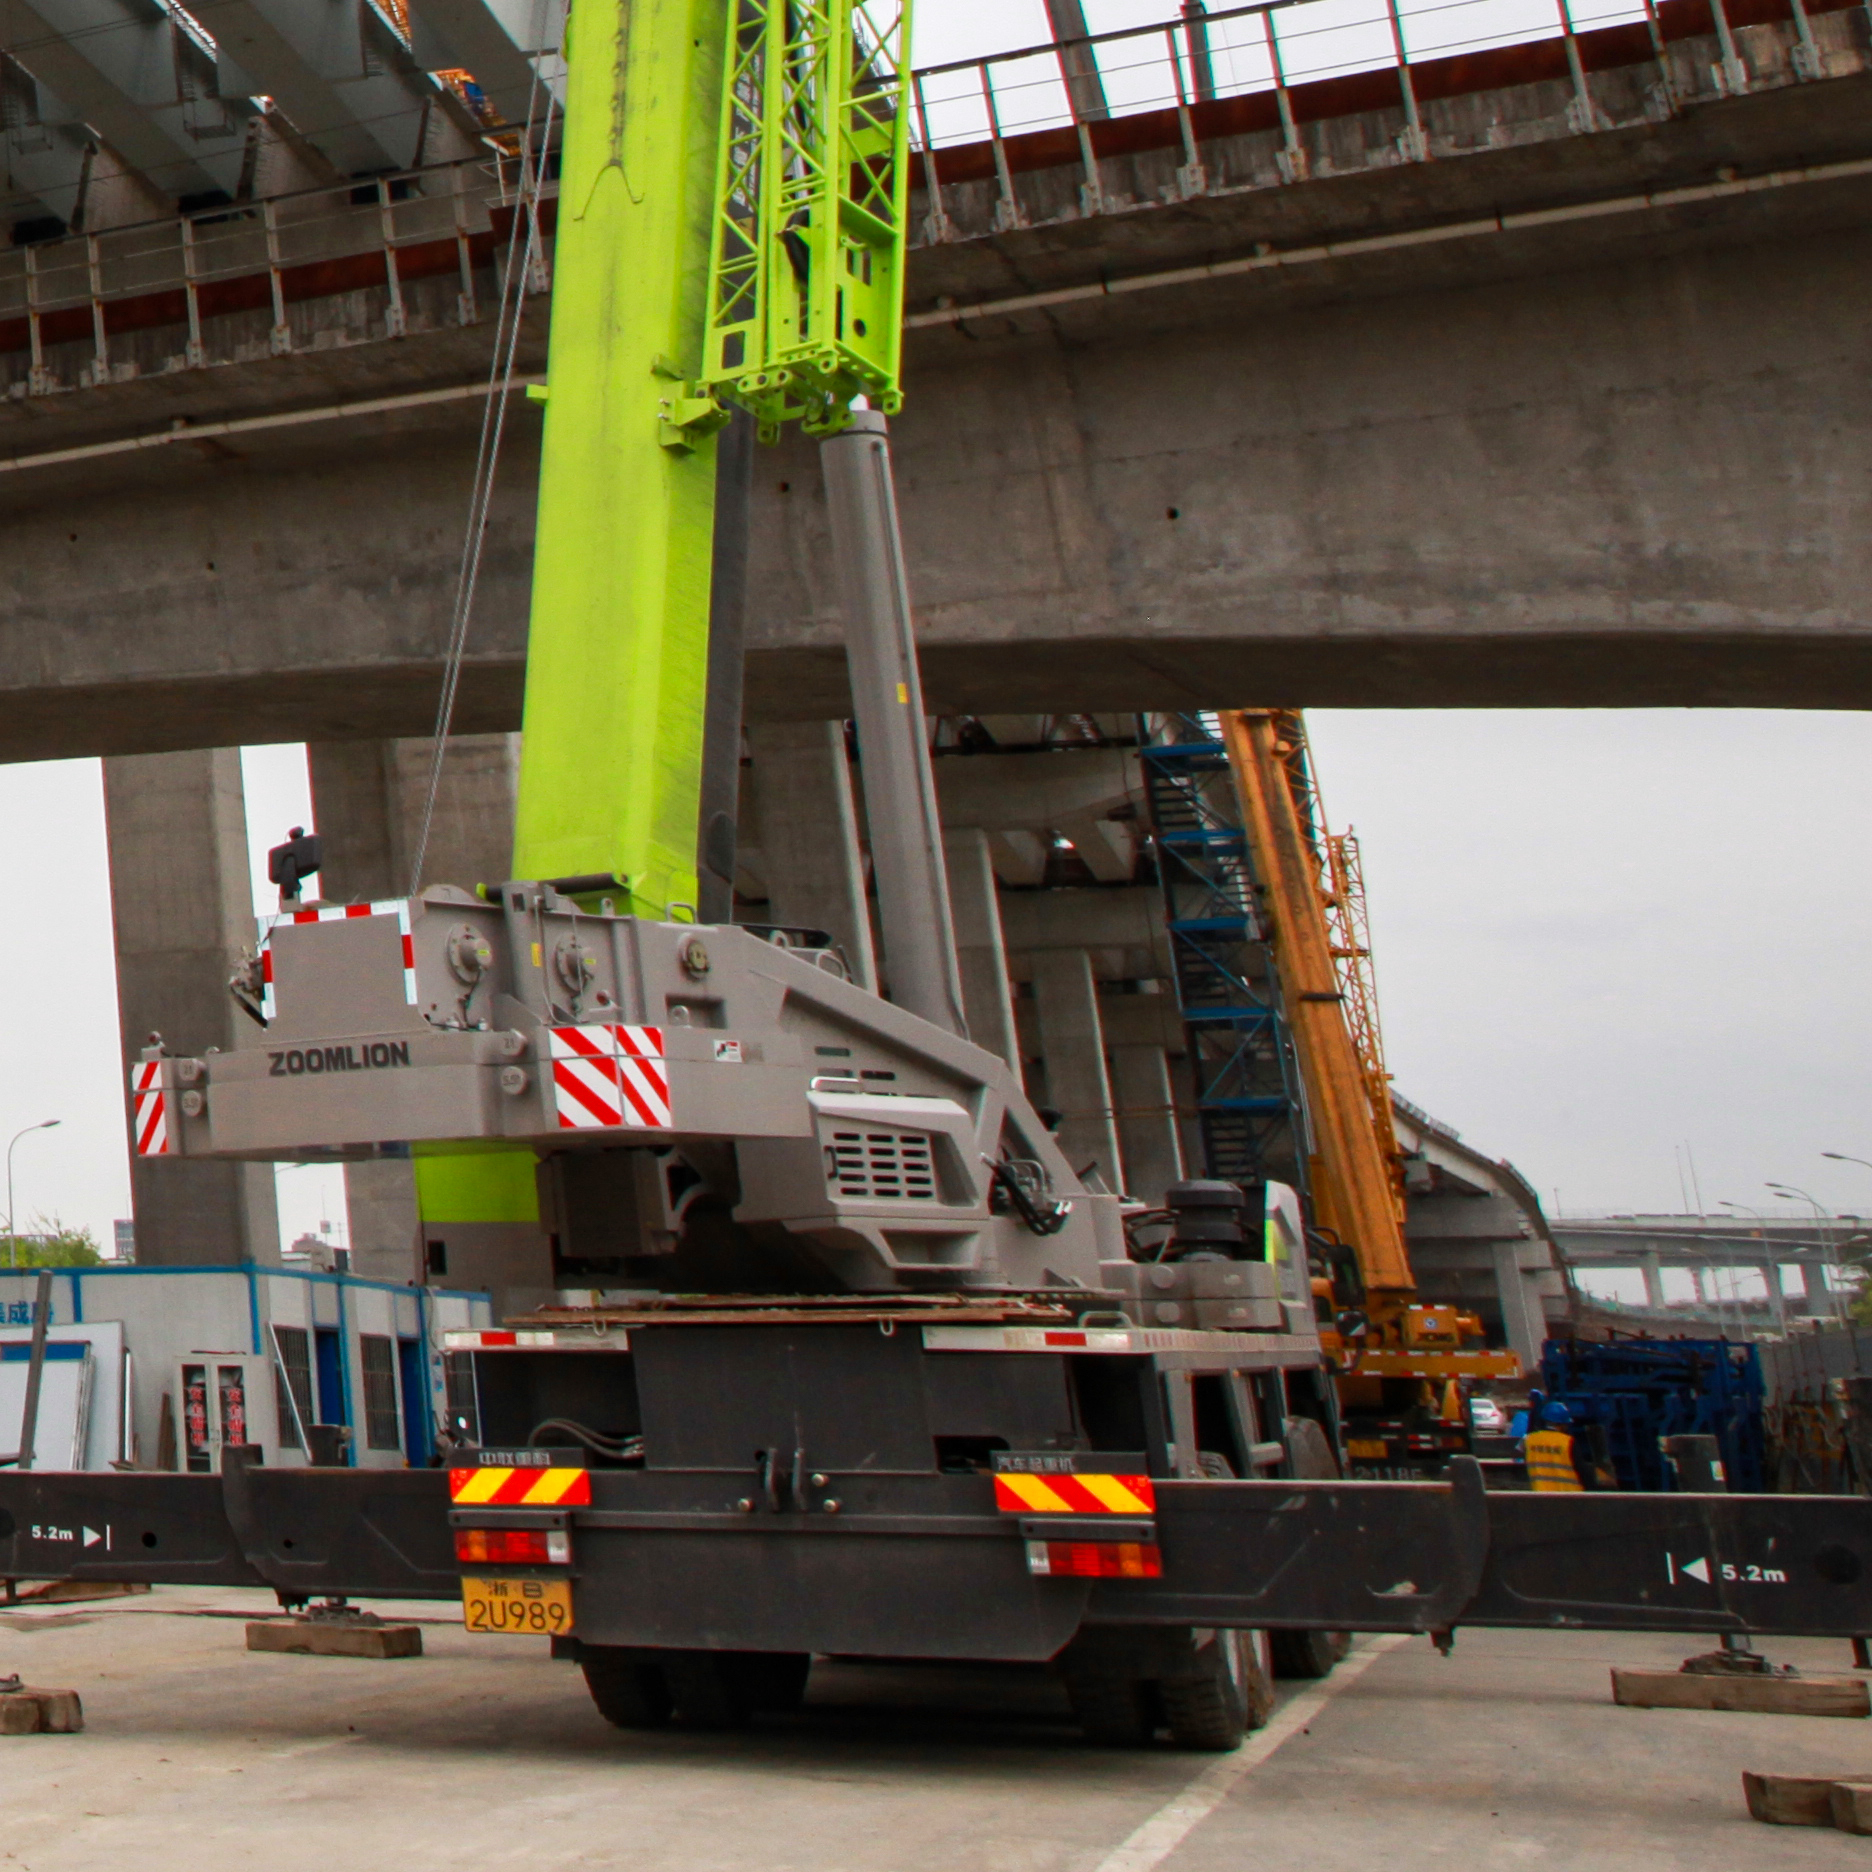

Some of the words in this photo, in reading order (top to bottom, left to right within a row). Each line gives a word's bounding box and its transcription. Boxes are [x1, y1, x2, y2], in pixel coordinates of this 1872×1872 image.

[268, 1041, 410, 1077] ZOOMLION
[996, 1456, 1073, 1472] 汽车起重机
[32, 1524, 73, 1541] 5.2m
[1721, 1564, 1786, 1582] 5.2m
[470, 1599, 564, 1630] 2U989
